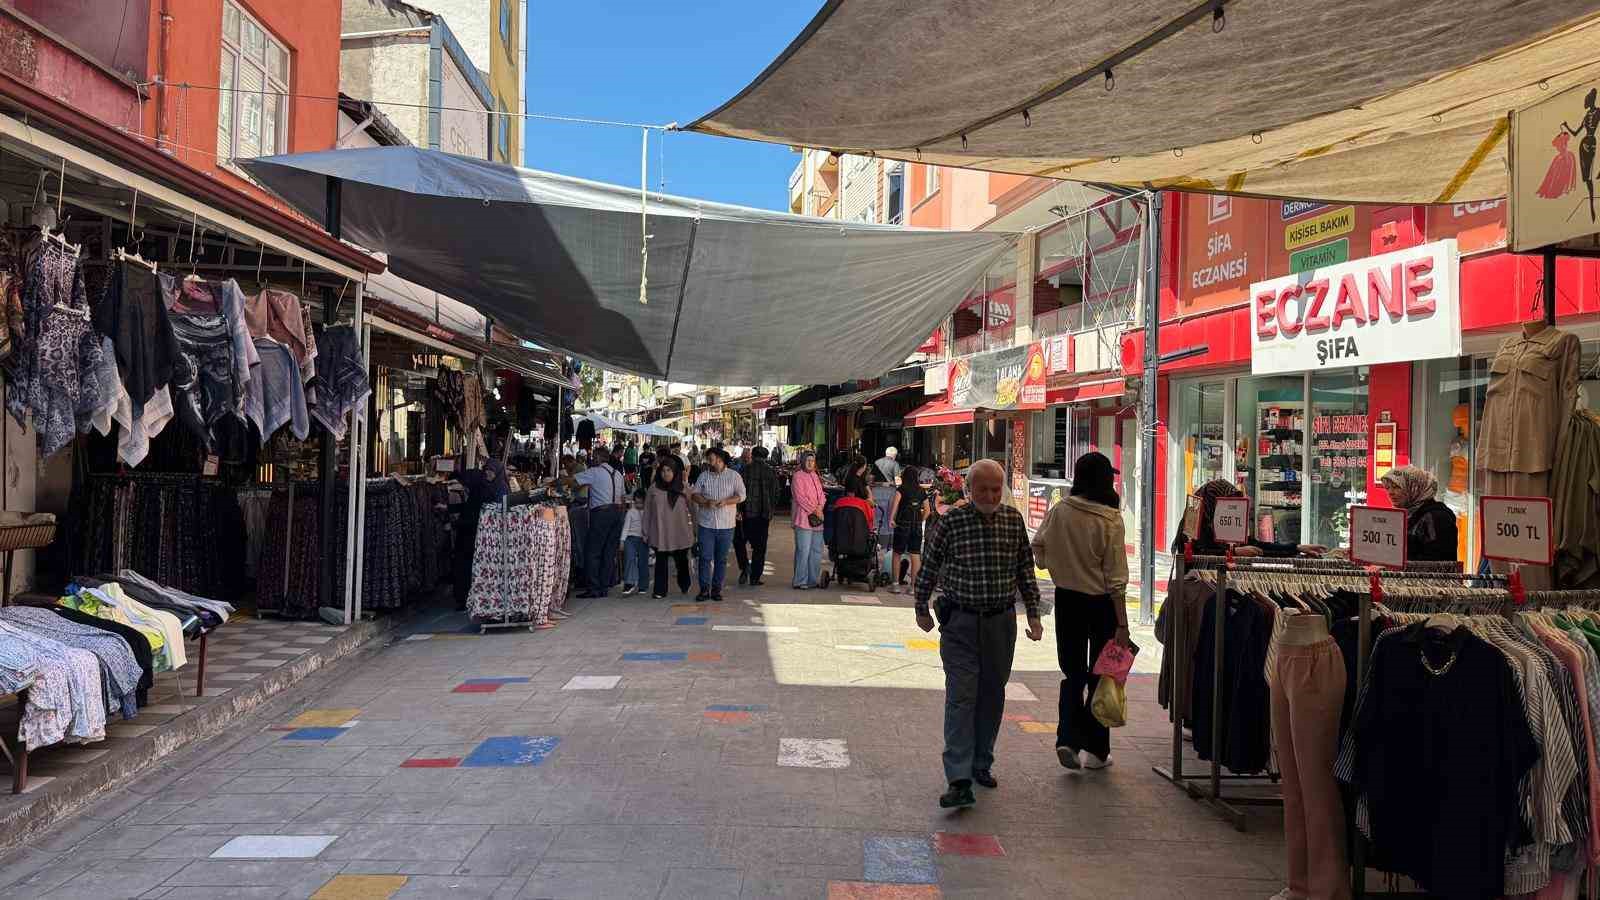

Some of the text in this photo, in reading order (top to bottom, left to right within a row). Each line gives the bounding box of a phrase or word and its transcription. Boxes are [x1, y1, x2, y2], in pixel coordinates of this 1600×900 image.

[1289, 214, 1349, 245] KİŞİSEL BAKIM
[1207, 232, 1232, 260] ŞİFA
[1192, 252, 1248, 288] ECZANESİ
[1256, 257, 1436, 339] ECZANE
[1219, 515, 1242, 528] 650 TL
[1496, 522, 1540, 540] 500 TL
[1362, 530, 1397, 546] 500 TL
